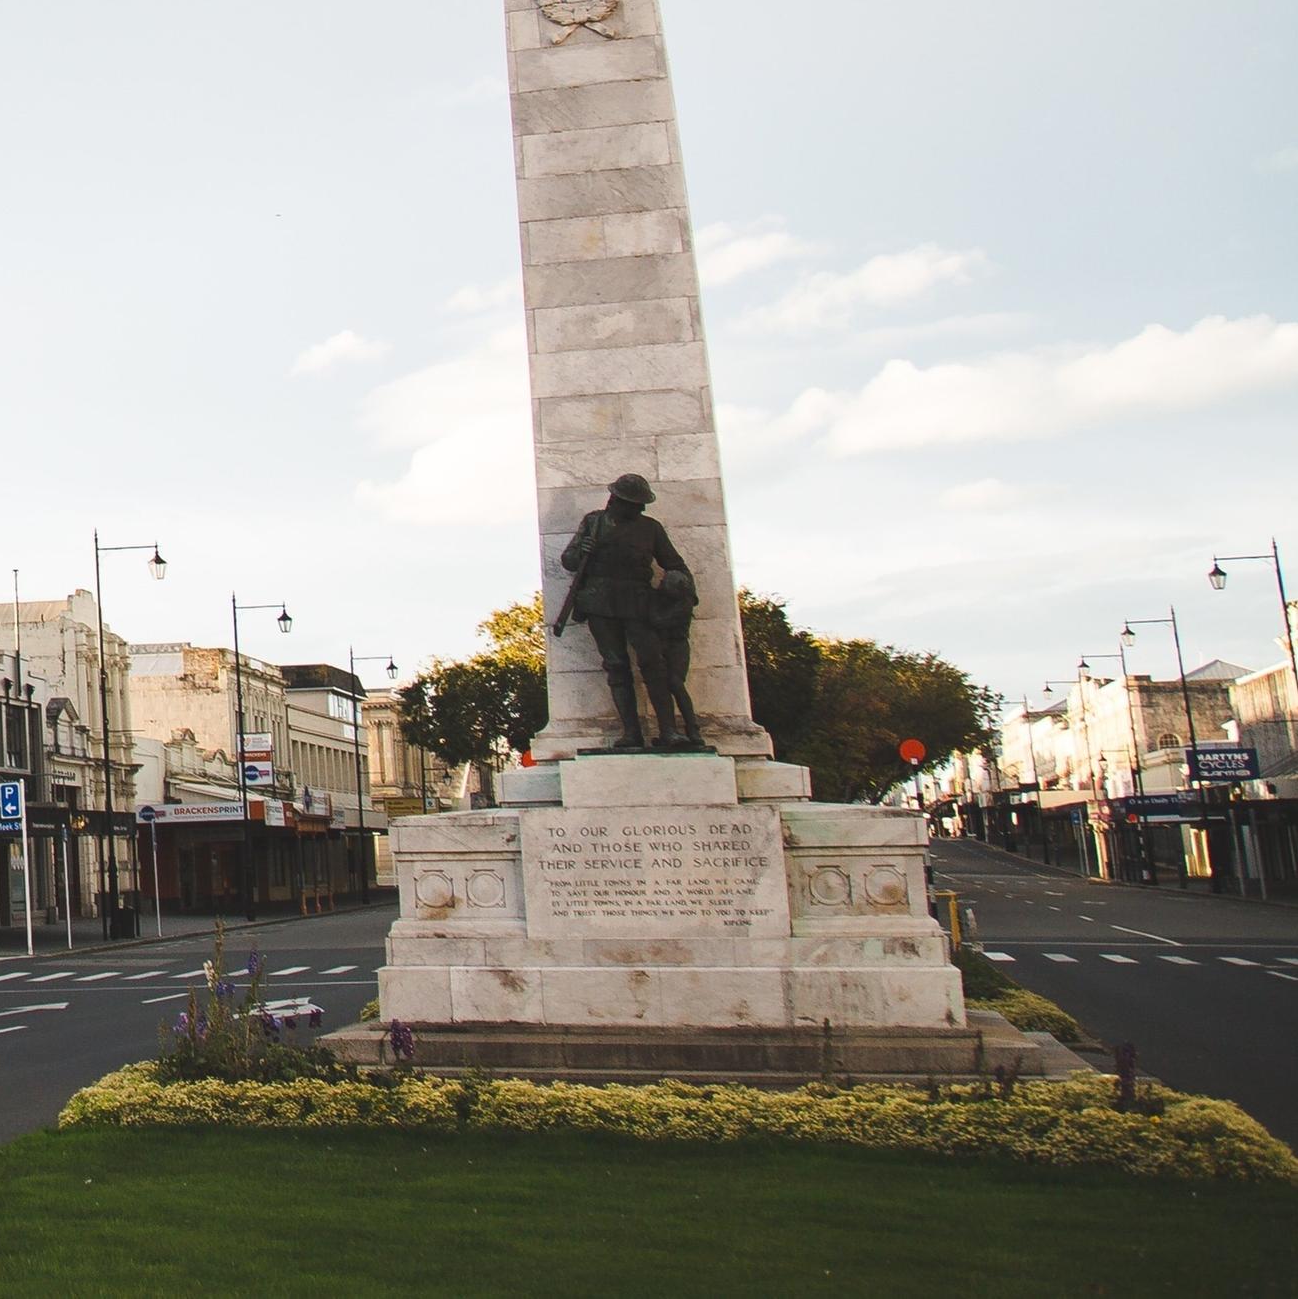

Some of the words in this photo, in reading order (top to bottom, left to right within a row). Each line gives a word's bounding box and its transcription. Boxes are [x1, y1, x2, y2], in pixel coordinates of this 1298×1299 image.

[1196, 752, 1250, 761] MARTYNS
[1198, 760, 1246, 769] CYCLES
[5, 786, 14, 799] P
[174, 805, 244, 815] BRACKENSPRINT
[547, 827, 566, 838] TO
[580, 826, 609, 837] OUR
[622, 824, 697, 837] GLORIOUS
[709, 823, 753, 835] DEAD
[552, 843, 583, 853] AND
[590, 842, 643, 853] THOSE
[648, 842, 683, 852] WHO
[693, 840, 751, 852] SHARED
[538, 859, 577, 870] THEIR
[584, 858, 643, 870] SERVICE
[651, 858, 683, 869] AND
[693, 856, 769, 868] SACRIFICE
[604, 879, 632, 887] TOWNS
[688, 878, 710, 886] LAND
[552, 909, 569, 917] AND
